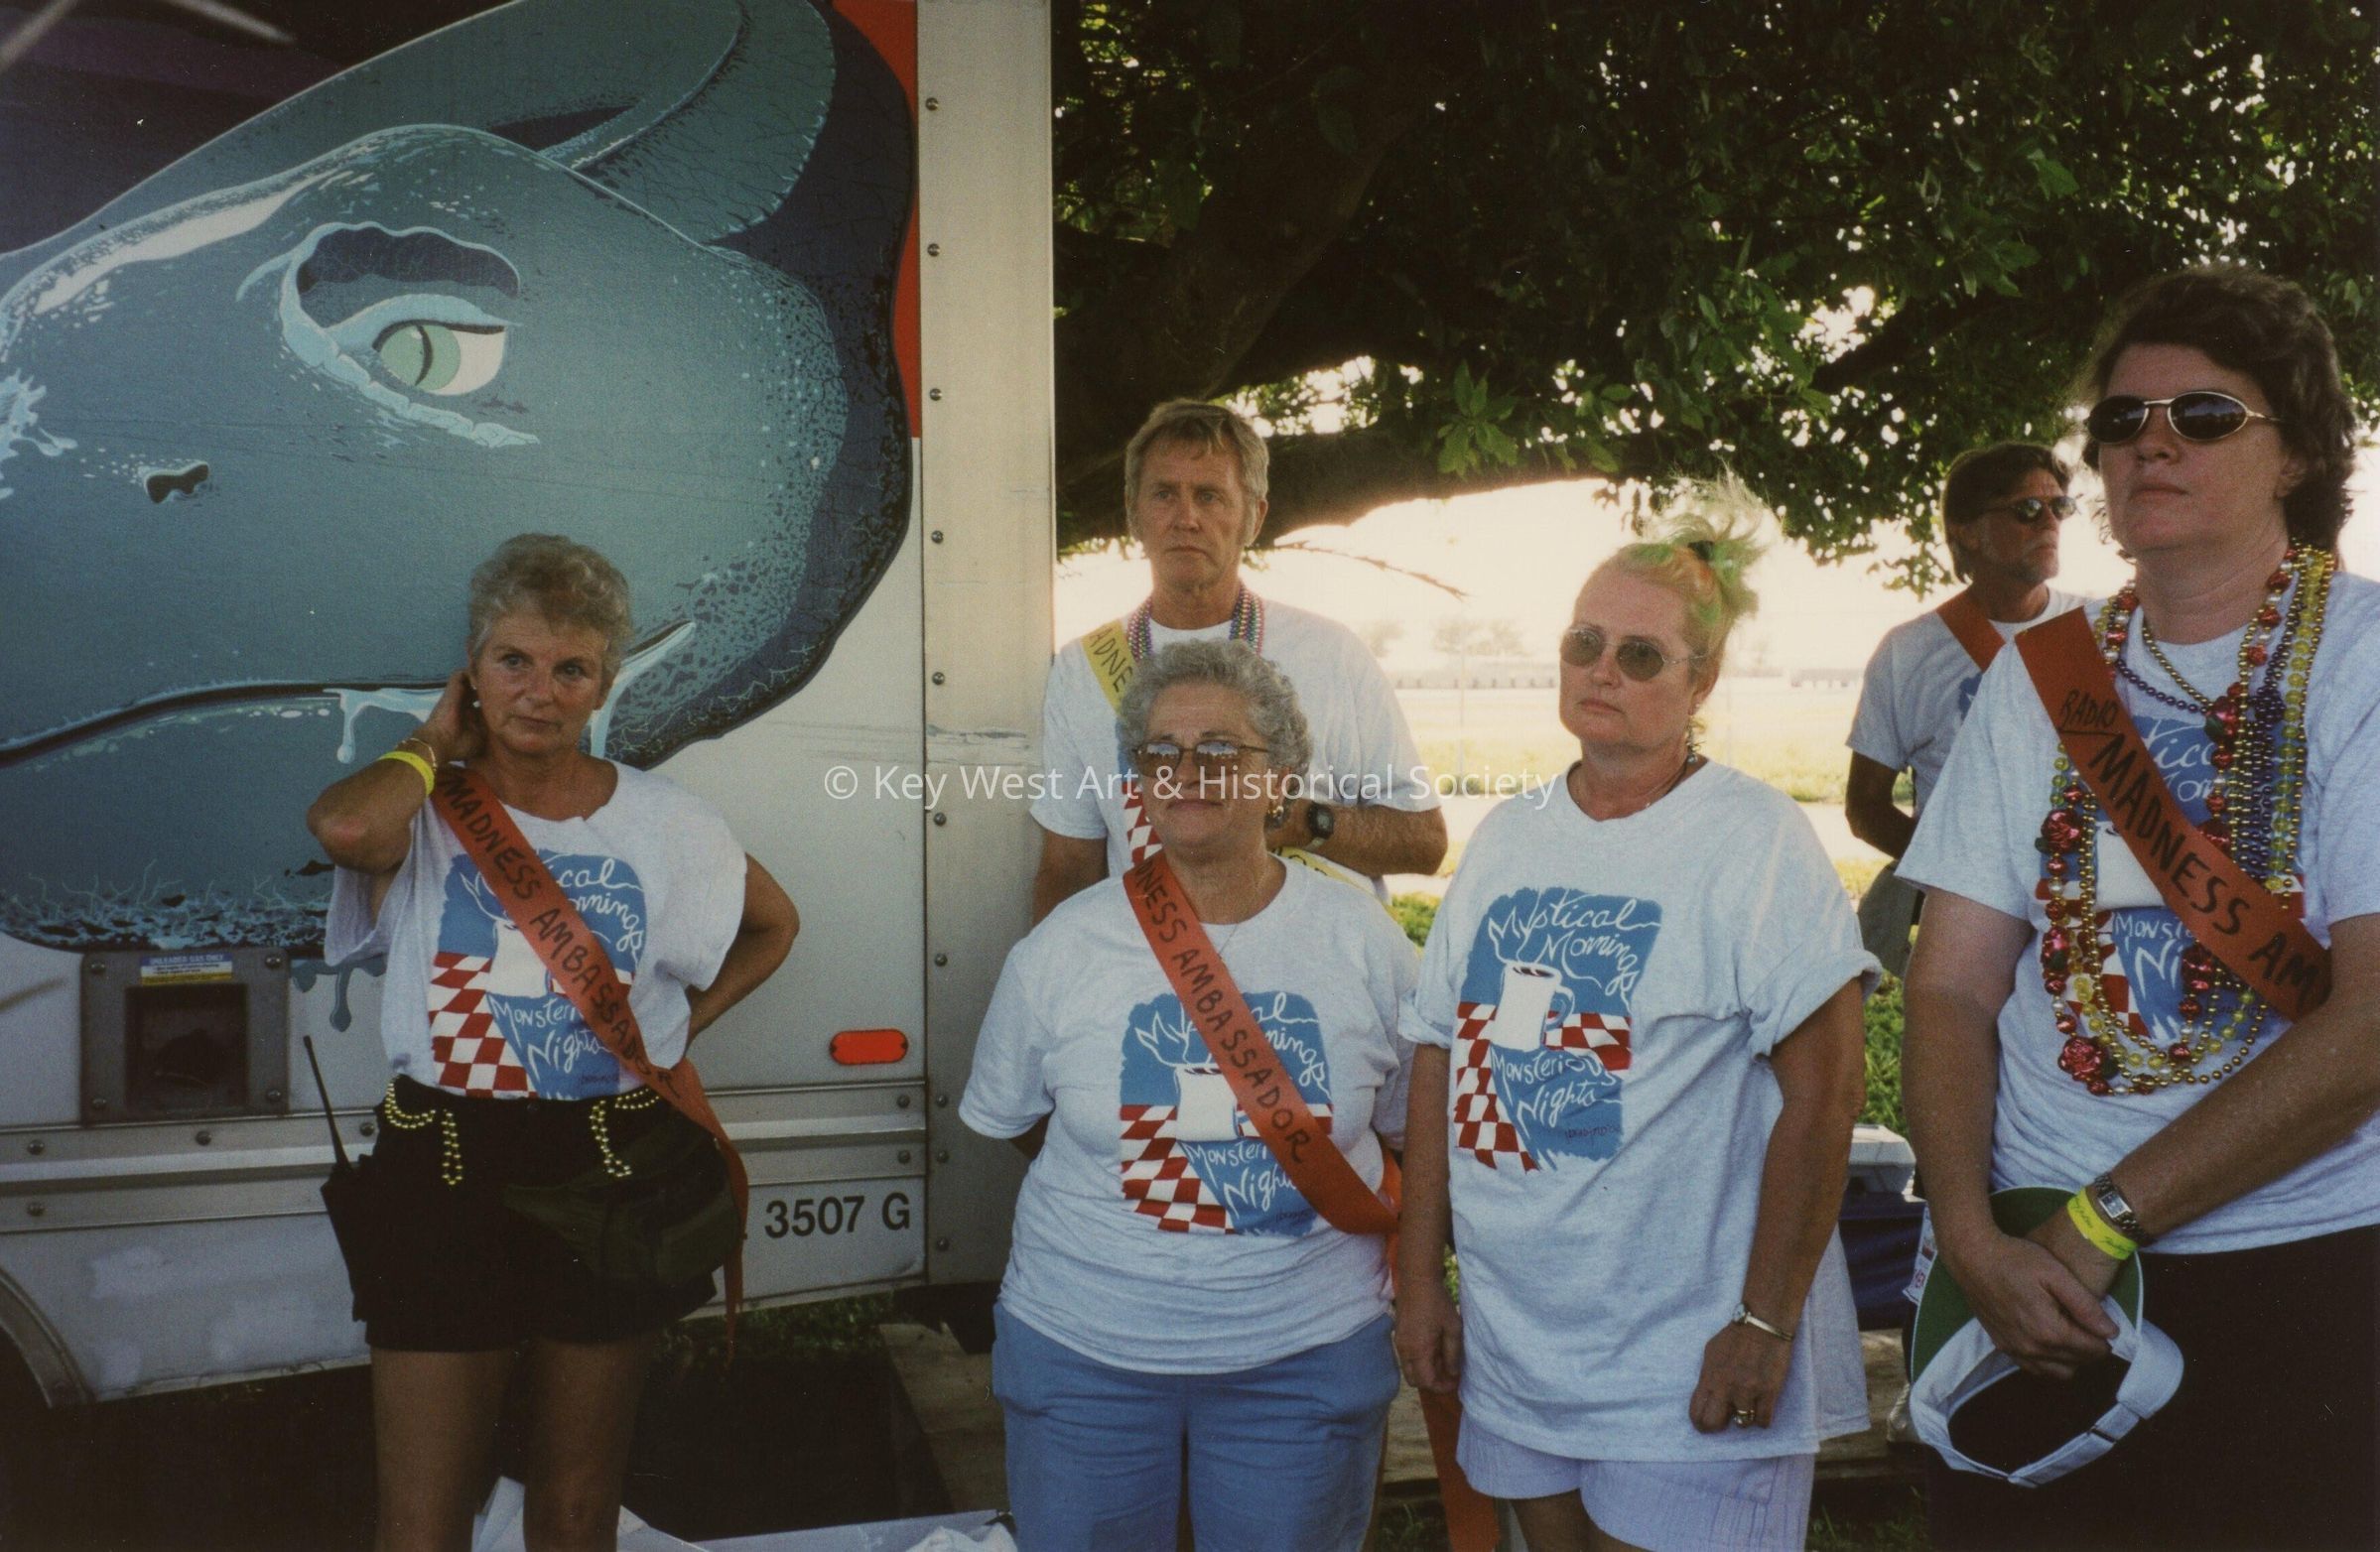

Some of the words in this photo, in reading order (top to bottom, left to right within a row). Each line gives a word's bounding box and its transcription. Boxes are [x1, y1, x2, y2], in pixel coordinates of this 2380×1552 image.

[2060, 688, 2118, 728] RADIO
[441, 775, 541, 899] MADNESS
[2088, 732, 2250, 936] MADNESS
[1489, 890, 1661, 961] Mystical
[1171, 948, 1312, 1163] AMBASSADOR
[1516, 1079, 1621, 1139] Nights
[764, 1195, 864, 1238] 3507
[881, 1192, 910, 1230] G
